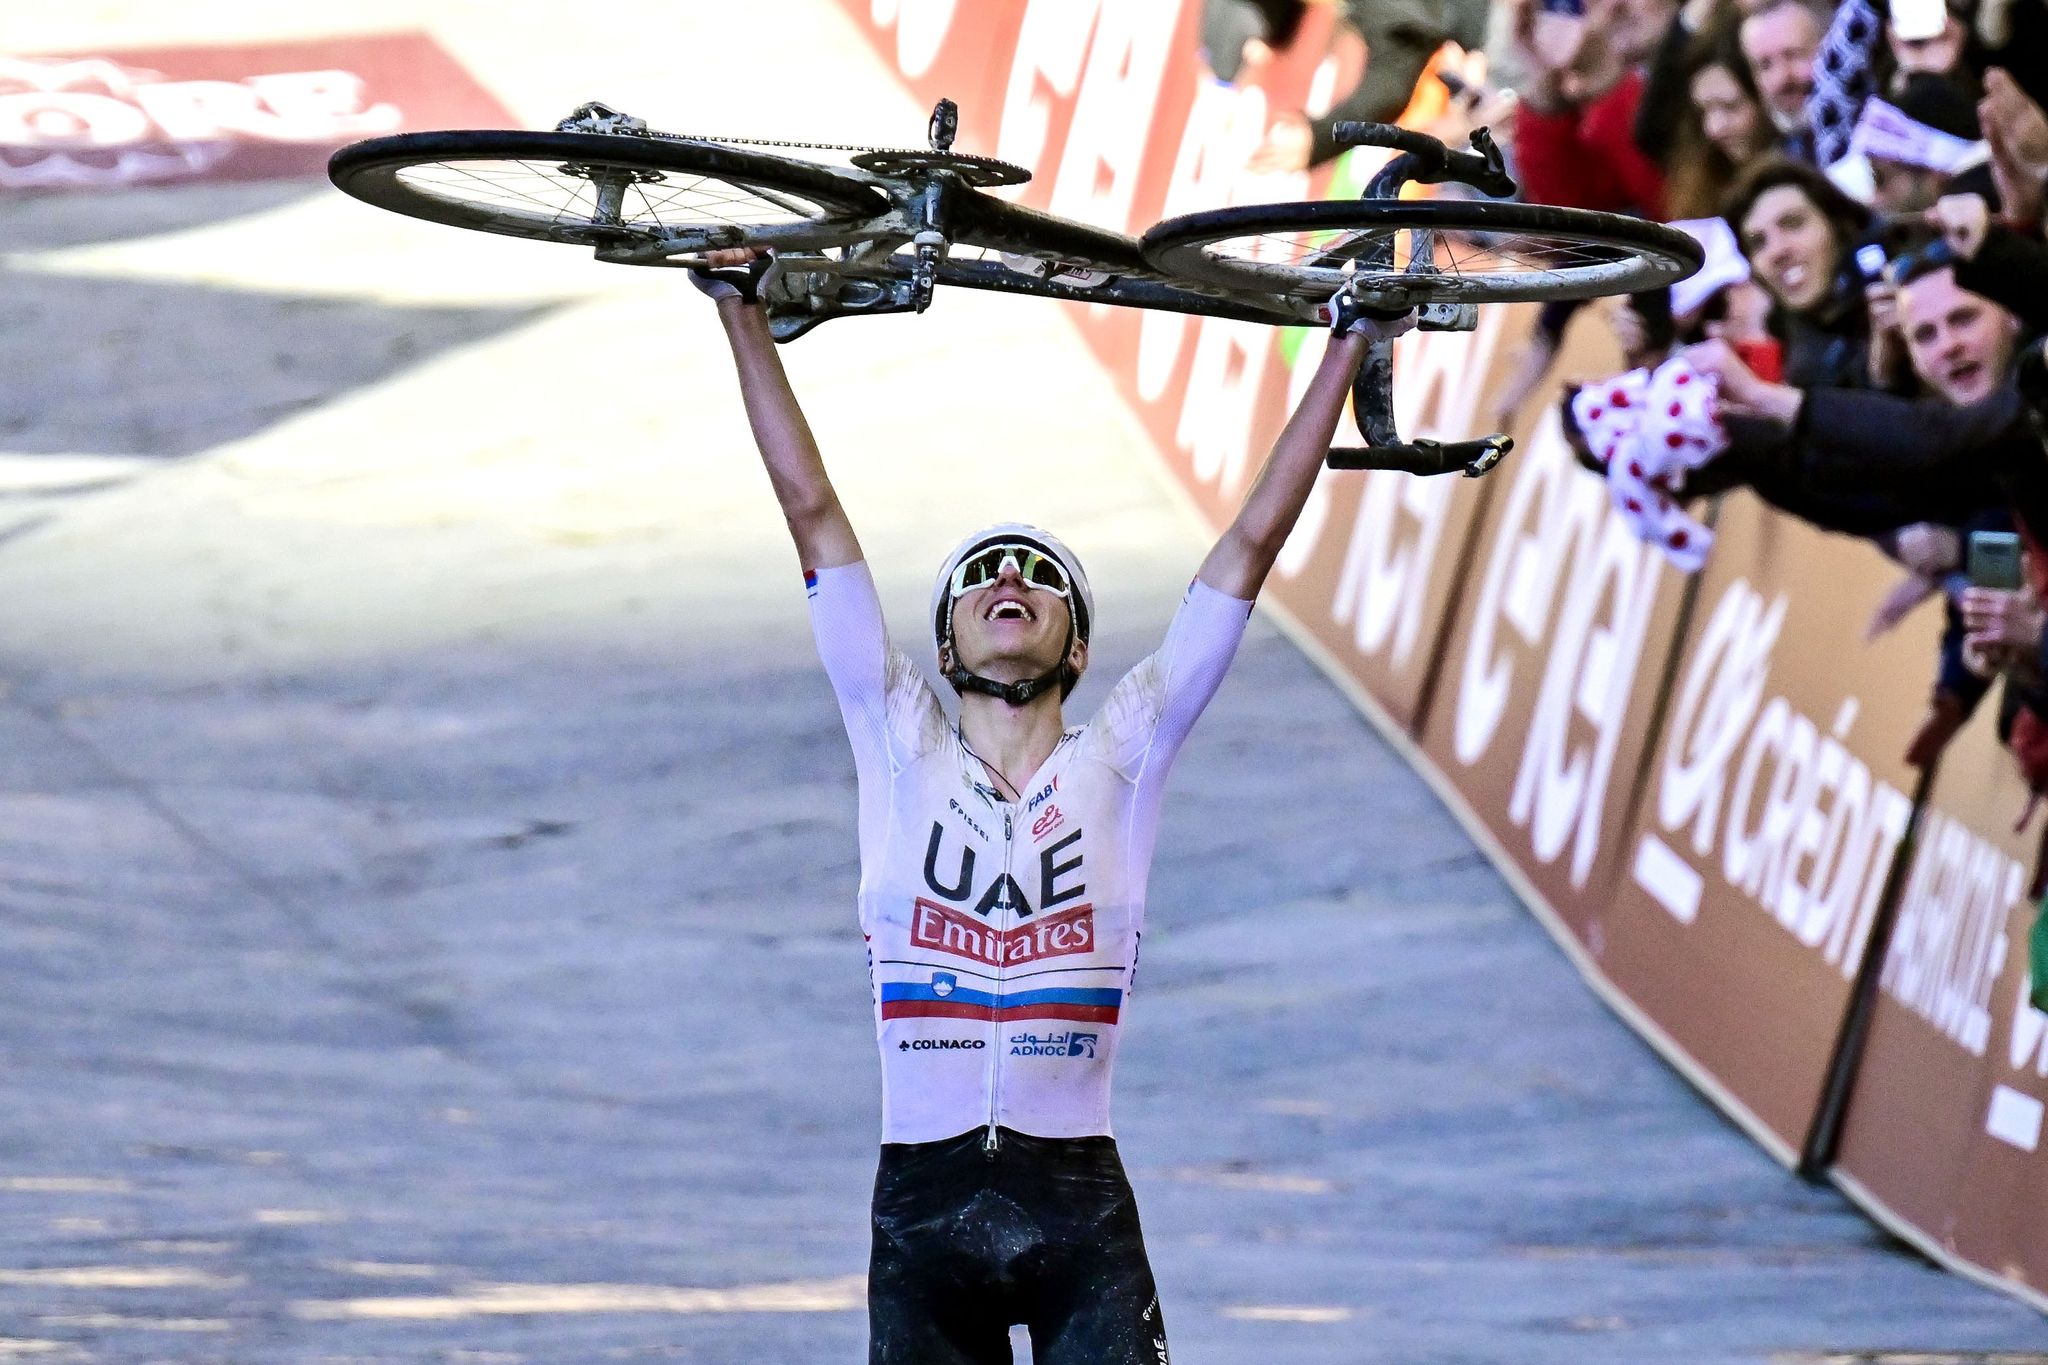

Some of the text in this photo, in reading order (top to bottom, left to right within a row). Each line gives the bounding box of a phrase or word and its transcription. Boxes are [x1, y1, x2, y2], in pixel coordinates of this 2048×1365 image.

[1028, 784, 1053, 812] FAB
[924, 820, 1086, 919] UAE
[917, 905, 1089, 963] Emirates
[912, 1039, 986, 1050] COLNAGO
[1010, 1046, 1066, 1056] ADNOC
[1153, 1338, 1168, 1365] AE
